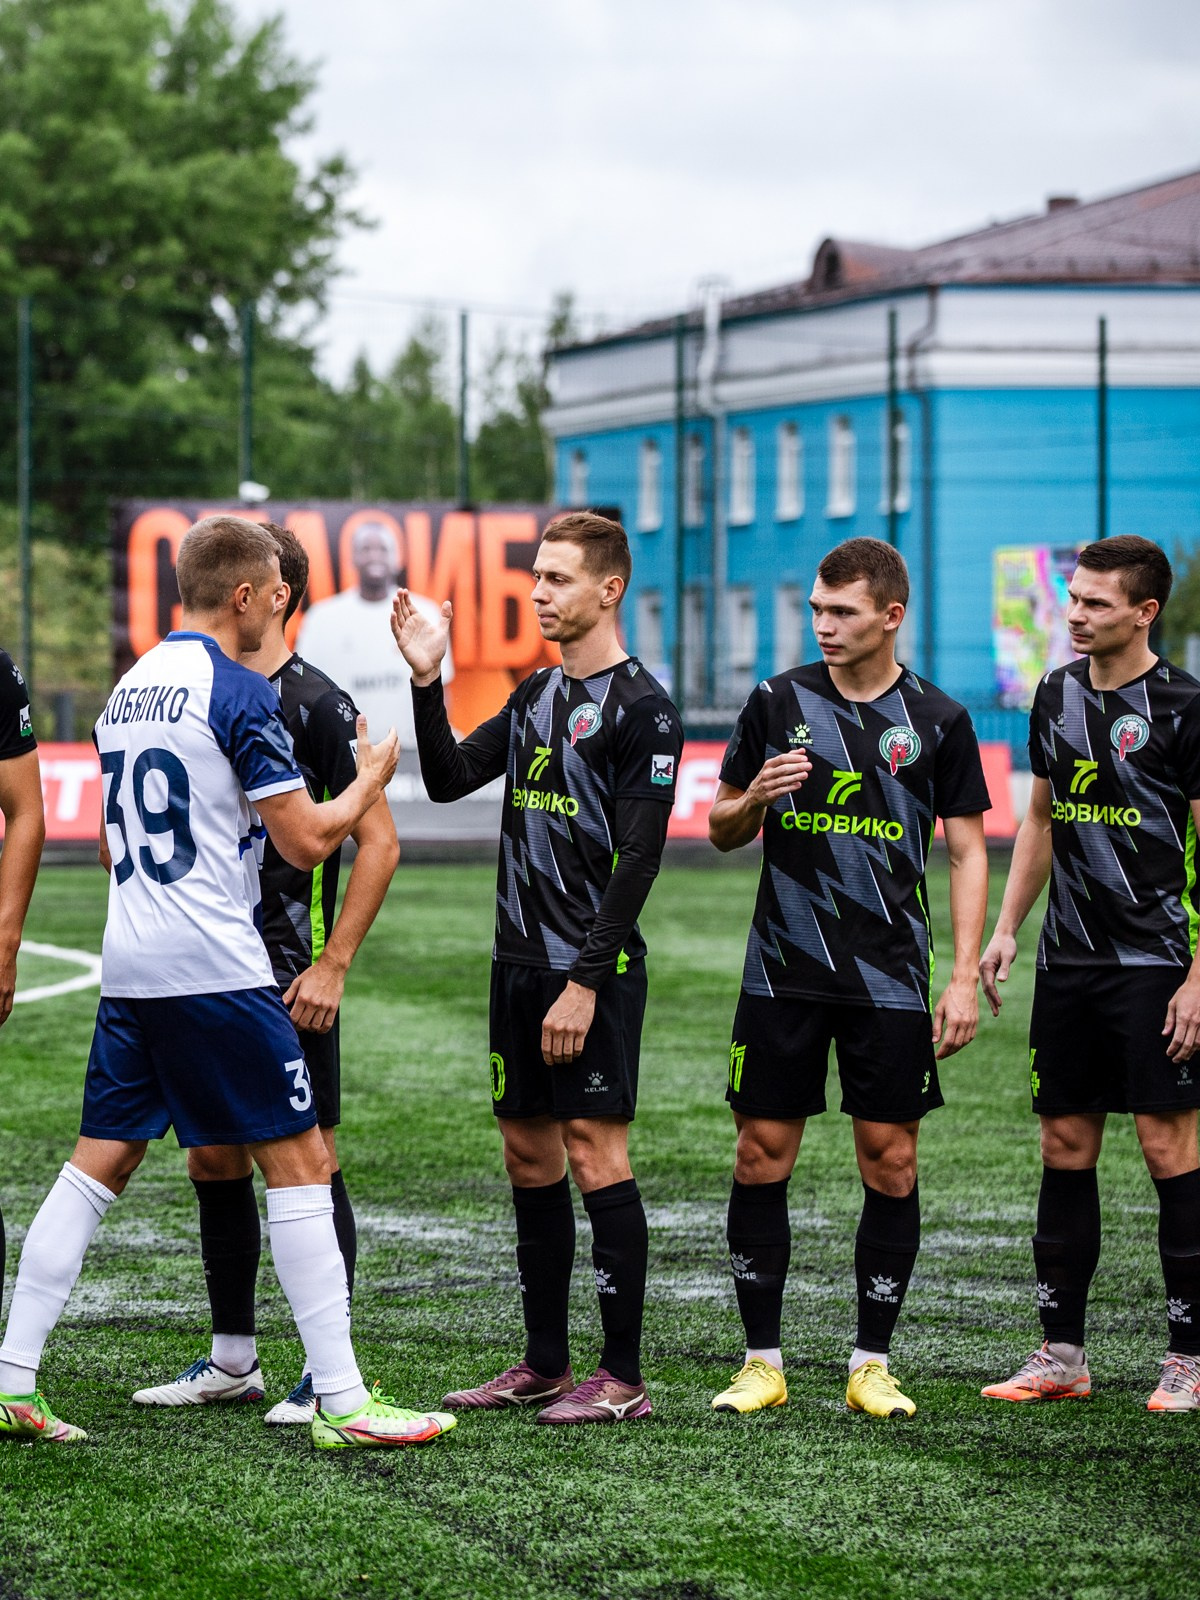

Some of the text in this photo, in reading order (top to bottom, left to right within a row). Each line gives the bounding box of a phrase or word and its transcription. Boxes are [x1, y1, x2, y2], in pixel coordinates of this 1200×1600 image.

[99, 748, 197, 886] 39
[781, 810, 904, 841] сервико
[284, 1058, 313, 1111] 3
[733, 1270, 757, 1280] ELME
[866, 1290, 898, 1303] KELME
[1037, 1301, 1059, 1309] ELME
[1167, 1313, 1192, 1324] ELME
